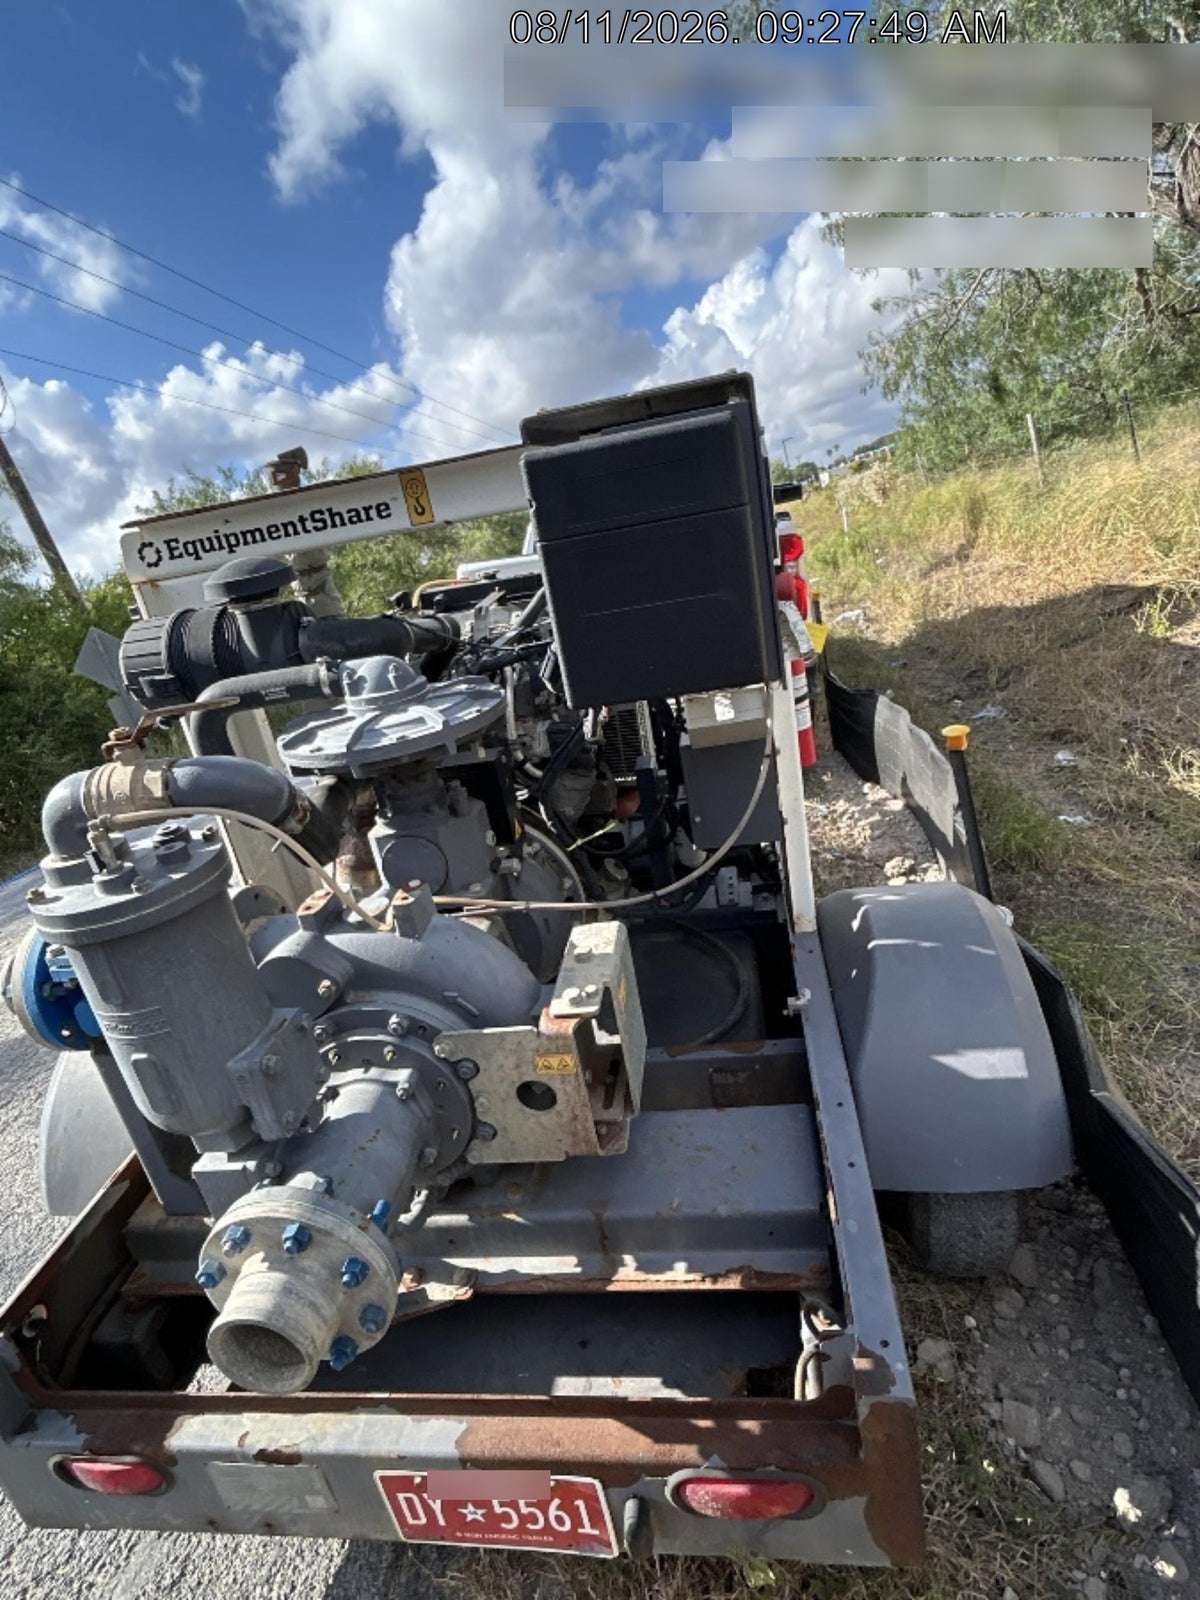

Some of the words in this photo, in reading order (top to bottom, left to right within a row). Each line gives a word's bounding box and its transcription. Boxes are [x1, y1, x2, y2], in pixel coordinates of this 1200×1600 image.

[165, 499, 392, 561] EquipmentShare
[396, 1492, 447, 1527] DY
[491, 1497, 600, 1536] 5561
